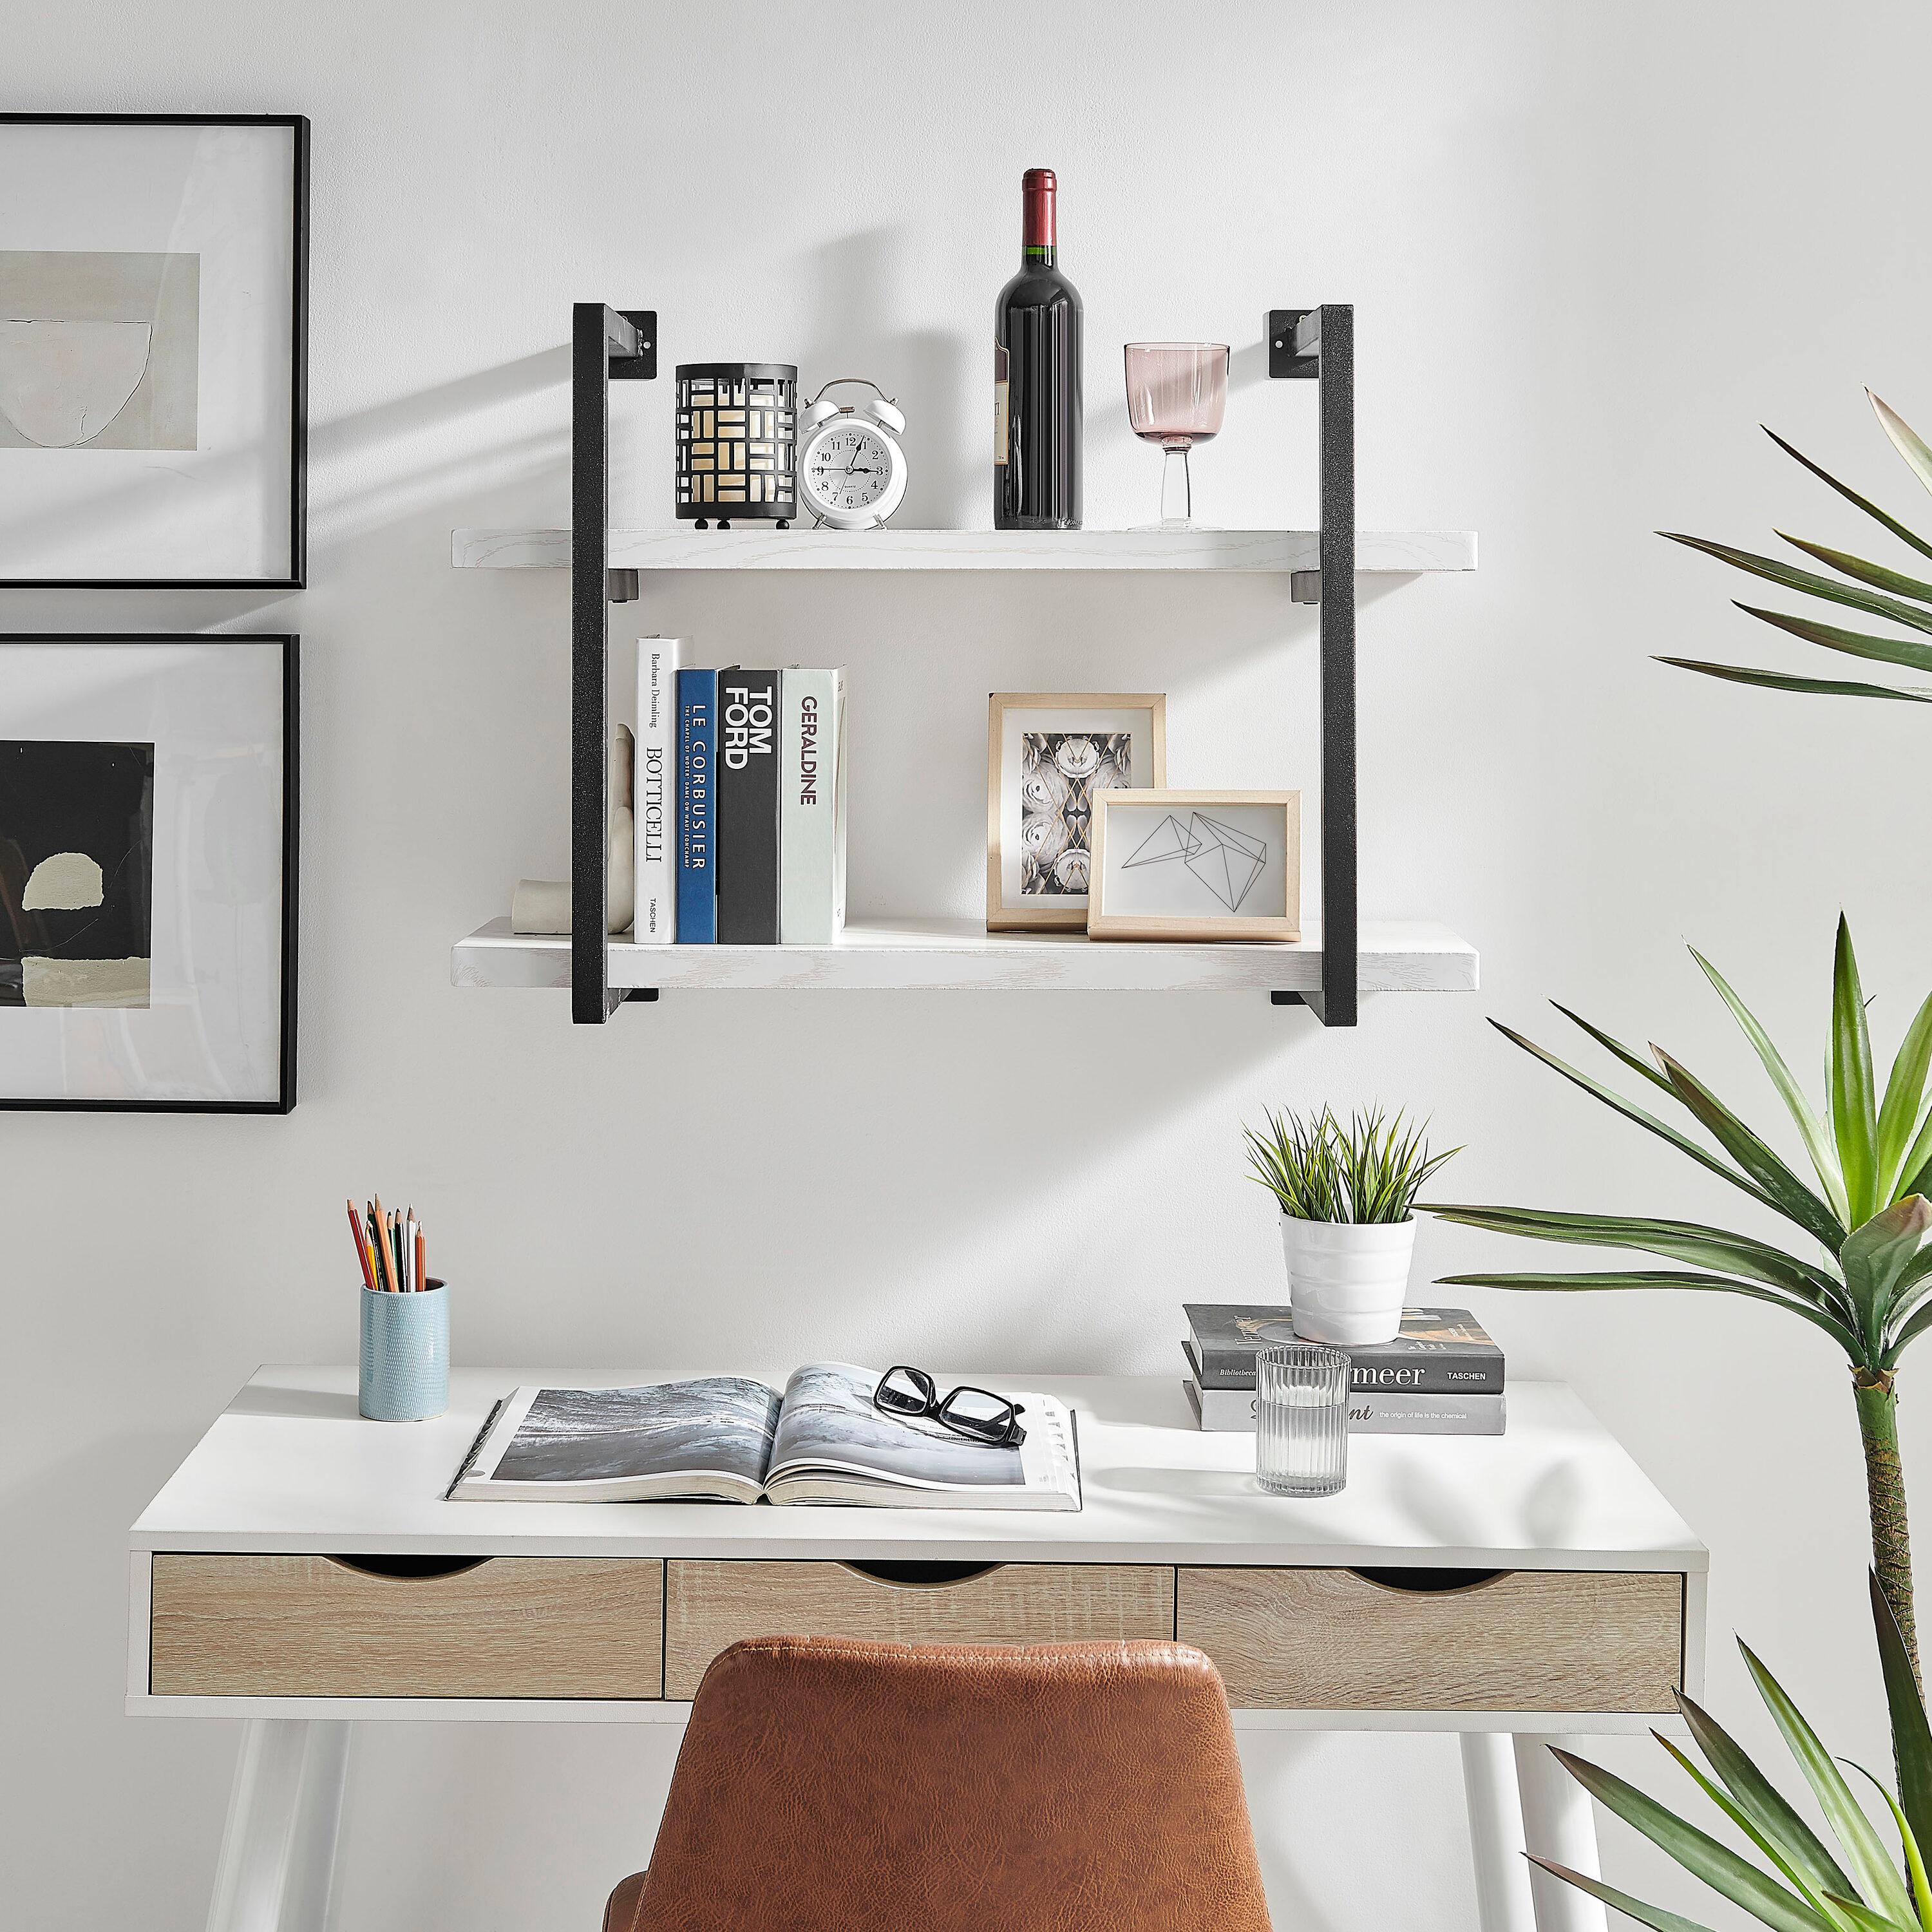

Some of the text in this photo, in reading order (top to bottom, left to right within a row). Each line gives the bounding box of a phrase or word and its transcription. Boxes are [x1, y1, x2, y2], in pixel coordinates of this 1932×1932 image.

[832, 441, 840, 450] 11
[845, 437, 857, 446] 12
[863, 441, 867, 450] 1
[821, 453, 831, 462] 10
[872, 450, 878, 460] 2
[817, 466, 824, 475] 9
[876, 466, 883, 475] 3
[822, 482, 829, 491] 8
[871, 480, 878, 489] 4
[832, 492, 838, 501] 7
[846, 495, 853, 505] 6
[862, 492, 868, 501] 5
[649, 653, 660, 728] Barbara Deimling
[748, 685, 773, 754] TOM
[725, 686, 748, 770] FORD
[685, 745, 690, 753] OF
[800, 696, 817, 806] GERALDINE
[692, 705, 706, 869] LE CORBUSIER
[646, 747, 663, 862] BOTTICELLI
[1349, 1367, 1426, 1385] meer
[1446, 1372, 1486, 1380] TASCHEN
